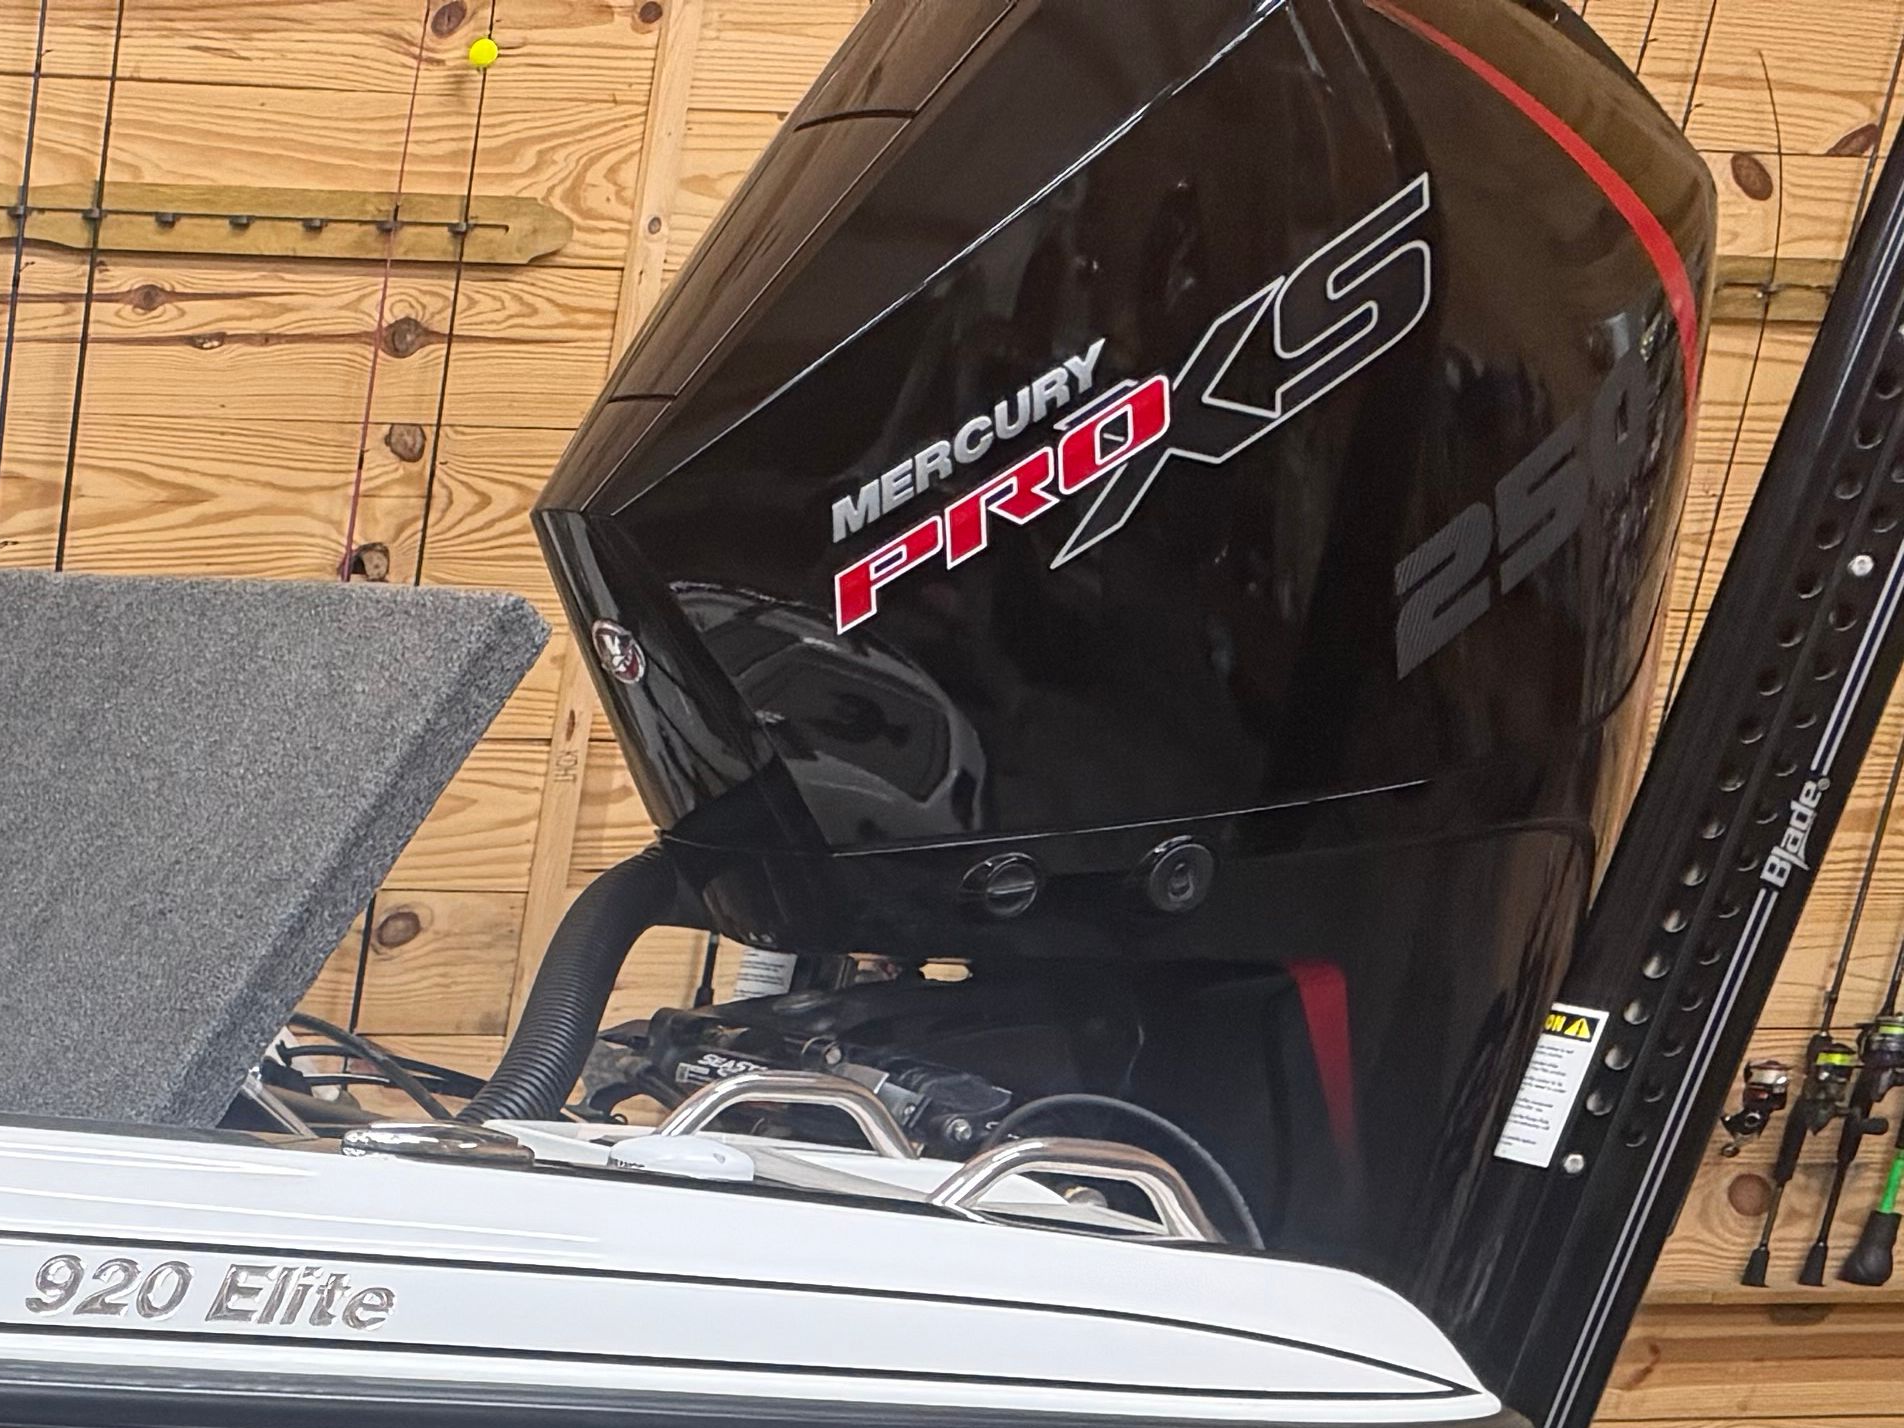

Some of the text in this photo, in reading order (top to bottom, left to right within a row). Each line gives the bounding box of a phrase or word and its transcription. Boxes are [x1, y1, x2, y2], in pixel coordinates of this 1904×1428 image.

[832, 337, 1107, 544] MERCURY
[1394, 347, 1654, 681] 250
[1759, 780, 1824, 888] Blade
[24, 1253, 398, 1331] 920 Elite
